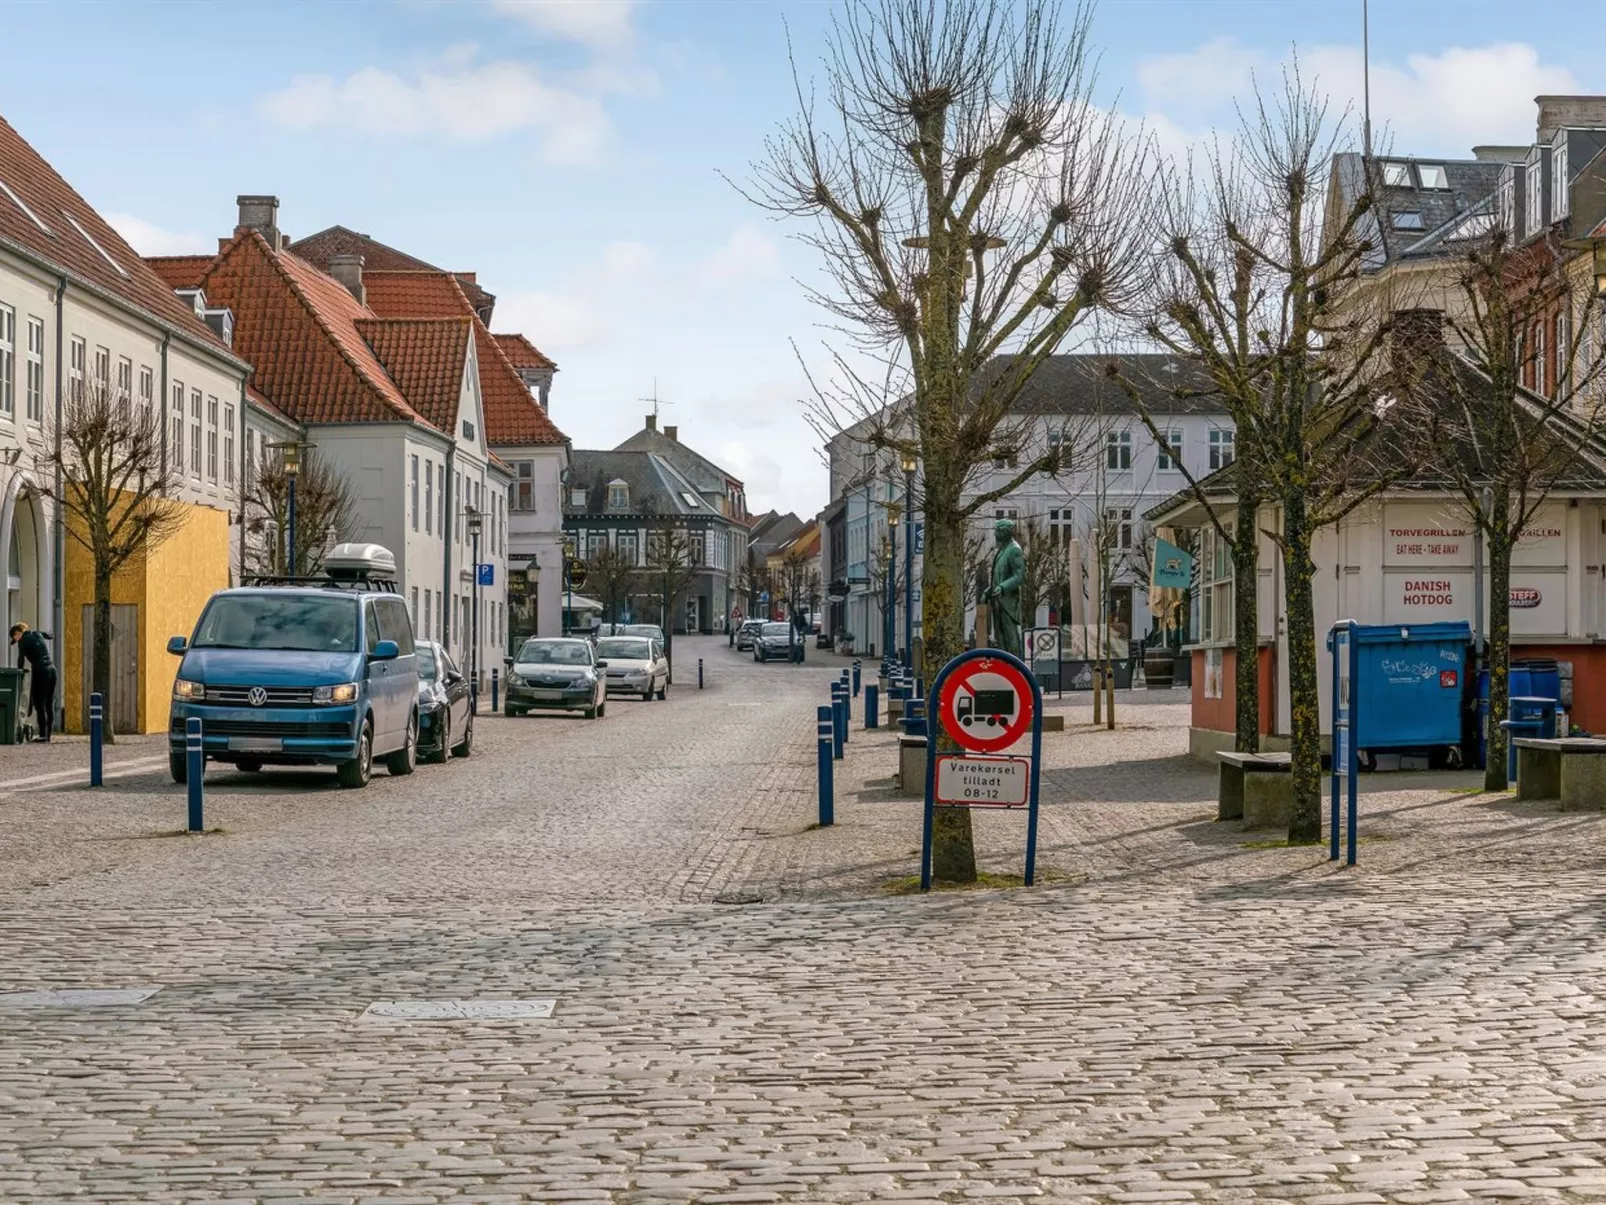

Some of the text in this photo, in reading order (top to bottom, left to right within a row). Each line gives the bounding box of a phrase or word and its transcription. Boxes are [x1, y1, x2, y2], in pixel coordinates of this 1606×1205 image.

[1389, 529, 1466, 537] TORVEGRILLEN
[1396, 544, 1407, 554] EAT
[1408, 544, 1423, 554] HERE
[1427, 544, 1441, 554] TAKE
[1442, 544, 1459, 554] AWAY
[1404, 581, 1451, 591] DANISH
[1403, 594, 1453, 605] HOTDOG
[951, 763, 1015, 774] Varekørsel
[963, 776, 1001, 786] tilladt
[964, 788, 999, 799] 08-12
